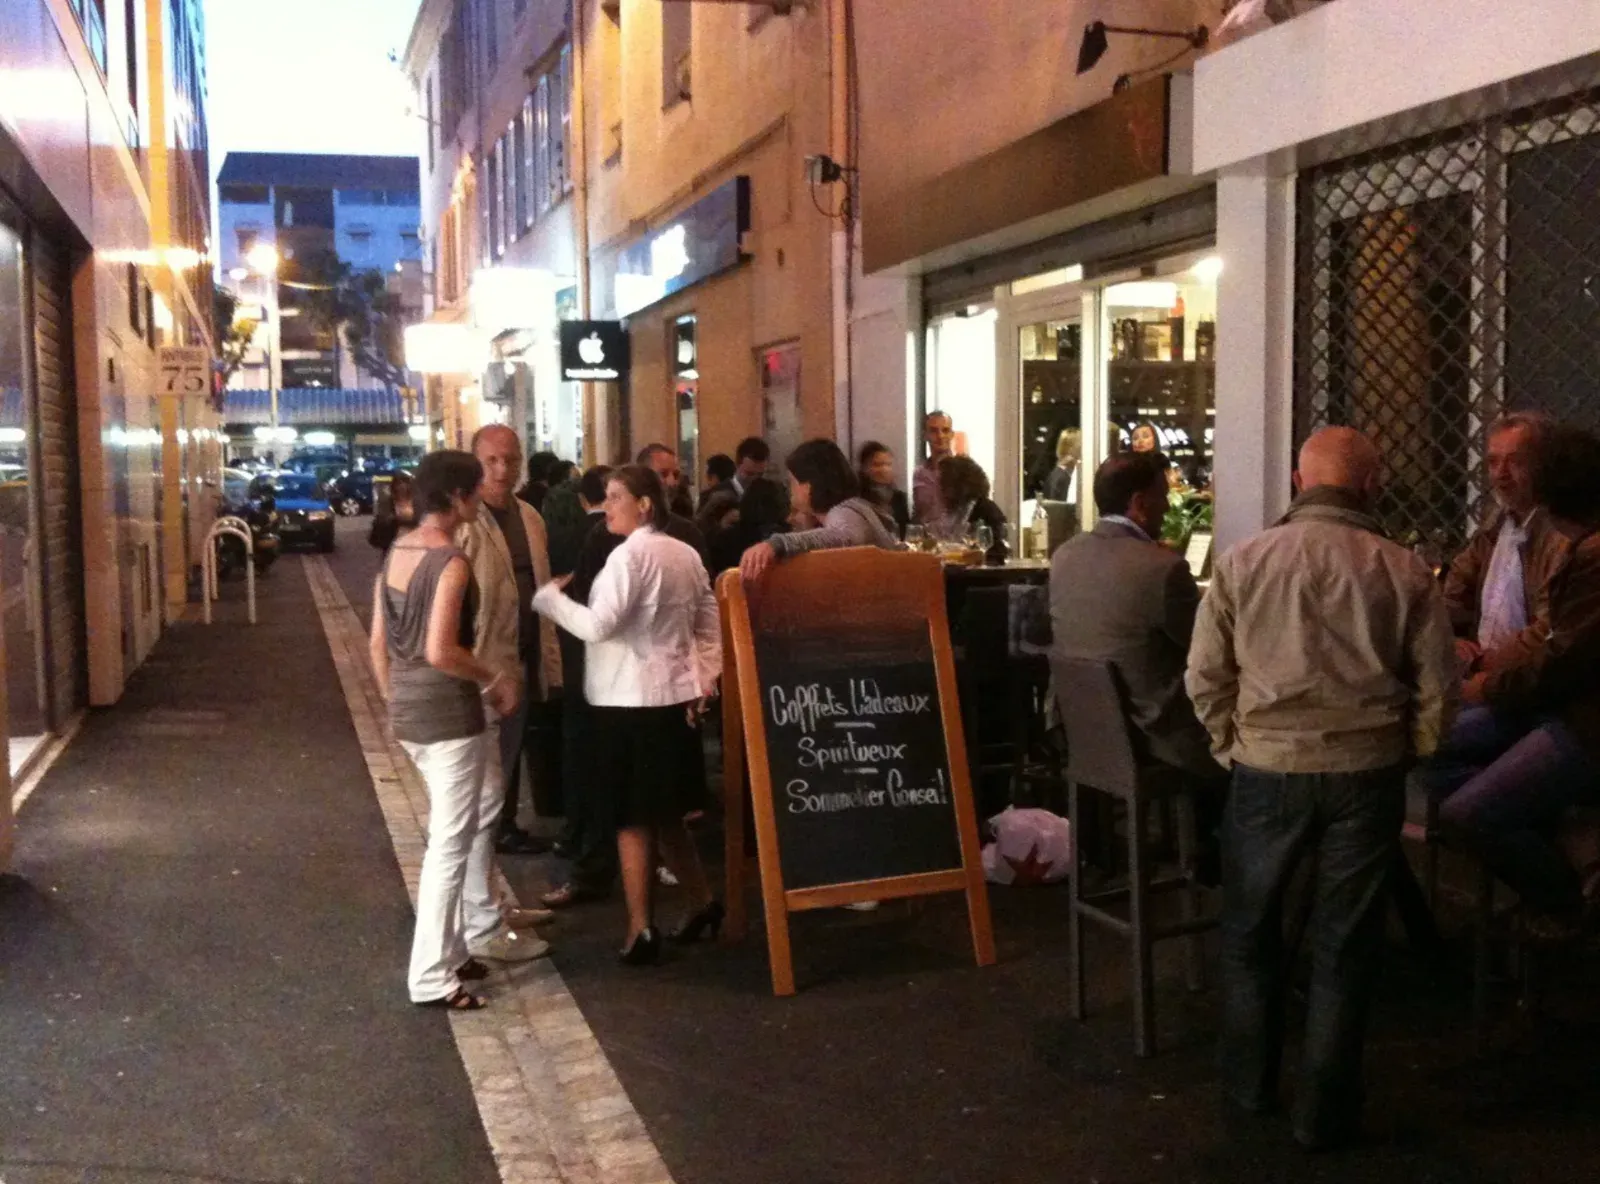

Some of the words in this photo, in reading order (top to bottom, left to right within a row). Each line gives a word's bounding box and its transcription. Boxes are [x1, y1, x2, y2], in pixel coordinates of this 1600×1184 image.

[161, 366, 204, 392] 75
[769, 683, 849, 733] Coffrets
[849, 678, 932, 717] Cadeaux
[797, 732, 907, 769] Spiritueux
